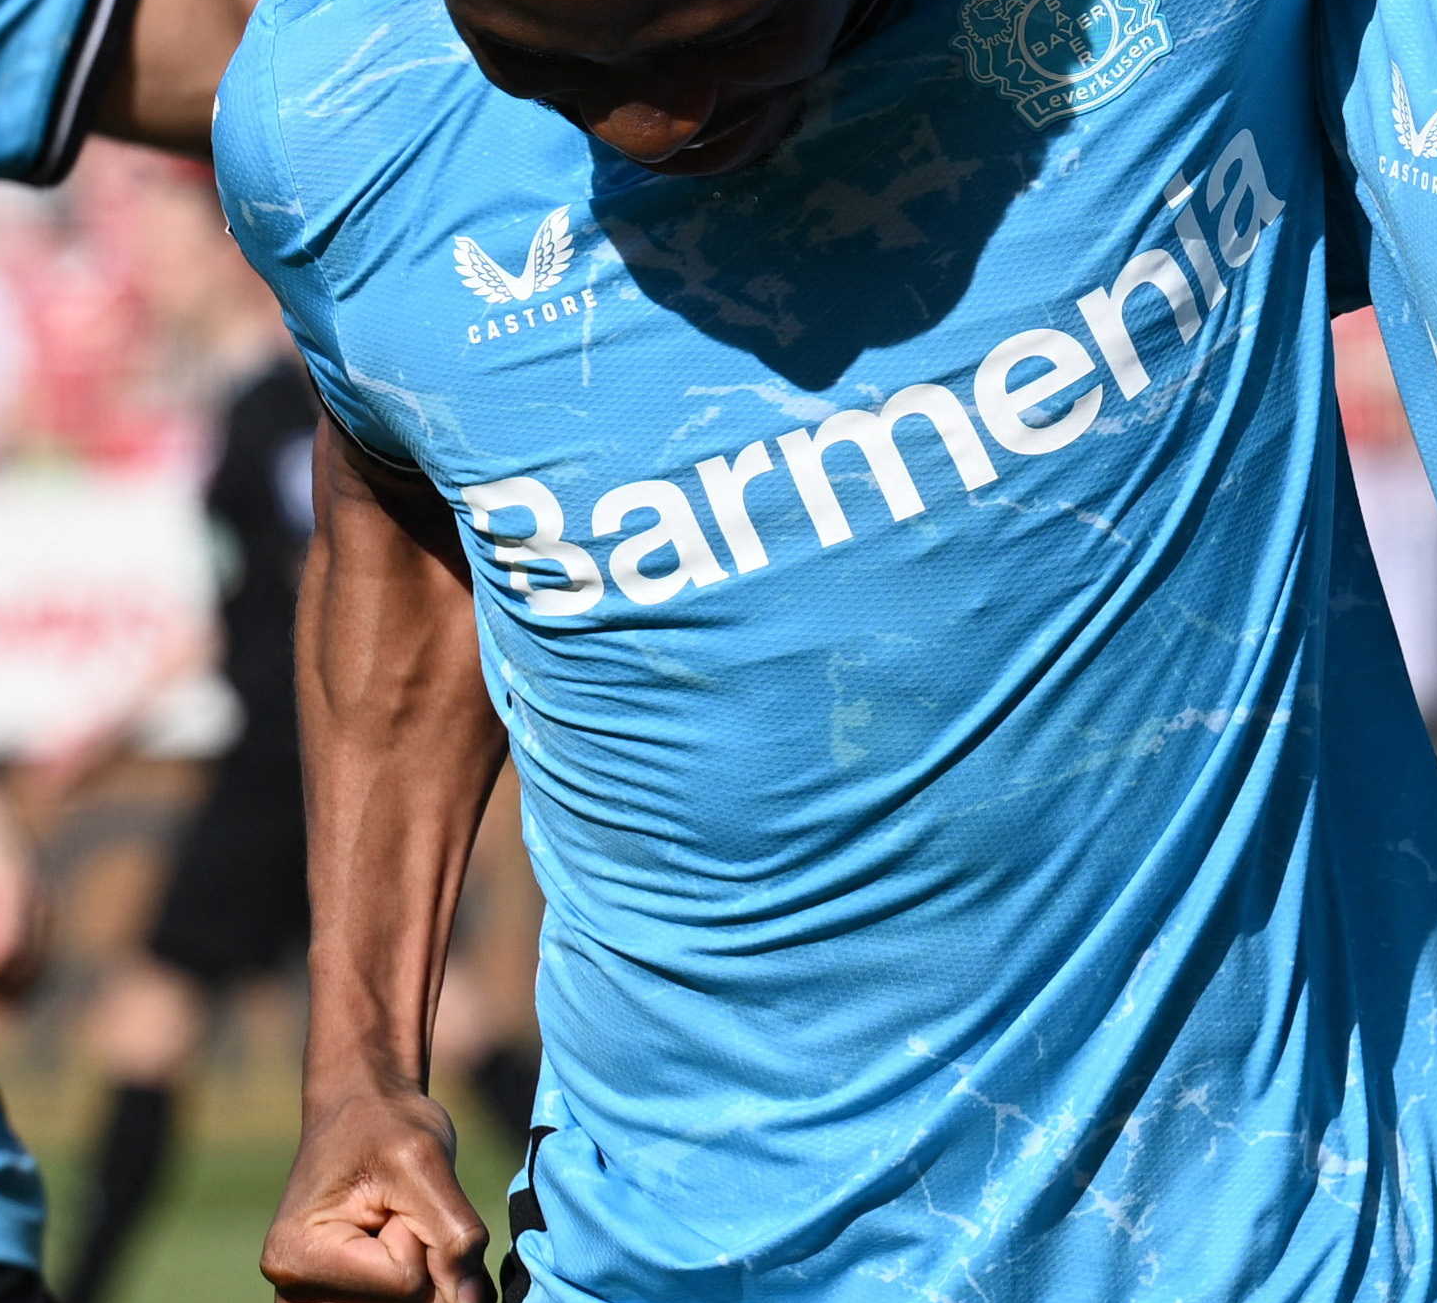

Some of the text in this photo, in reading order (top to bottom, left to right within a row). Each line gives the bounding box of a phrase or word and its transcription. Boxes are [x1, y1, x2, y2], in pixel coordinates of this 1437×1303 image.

[1032, 4, 1108, 57] BAYER
[1032, 35, 1155, 115] Leverkusen
[467, 287, 599, 345] CASTORE
[462, 128, 1286, 617] Barmenia
